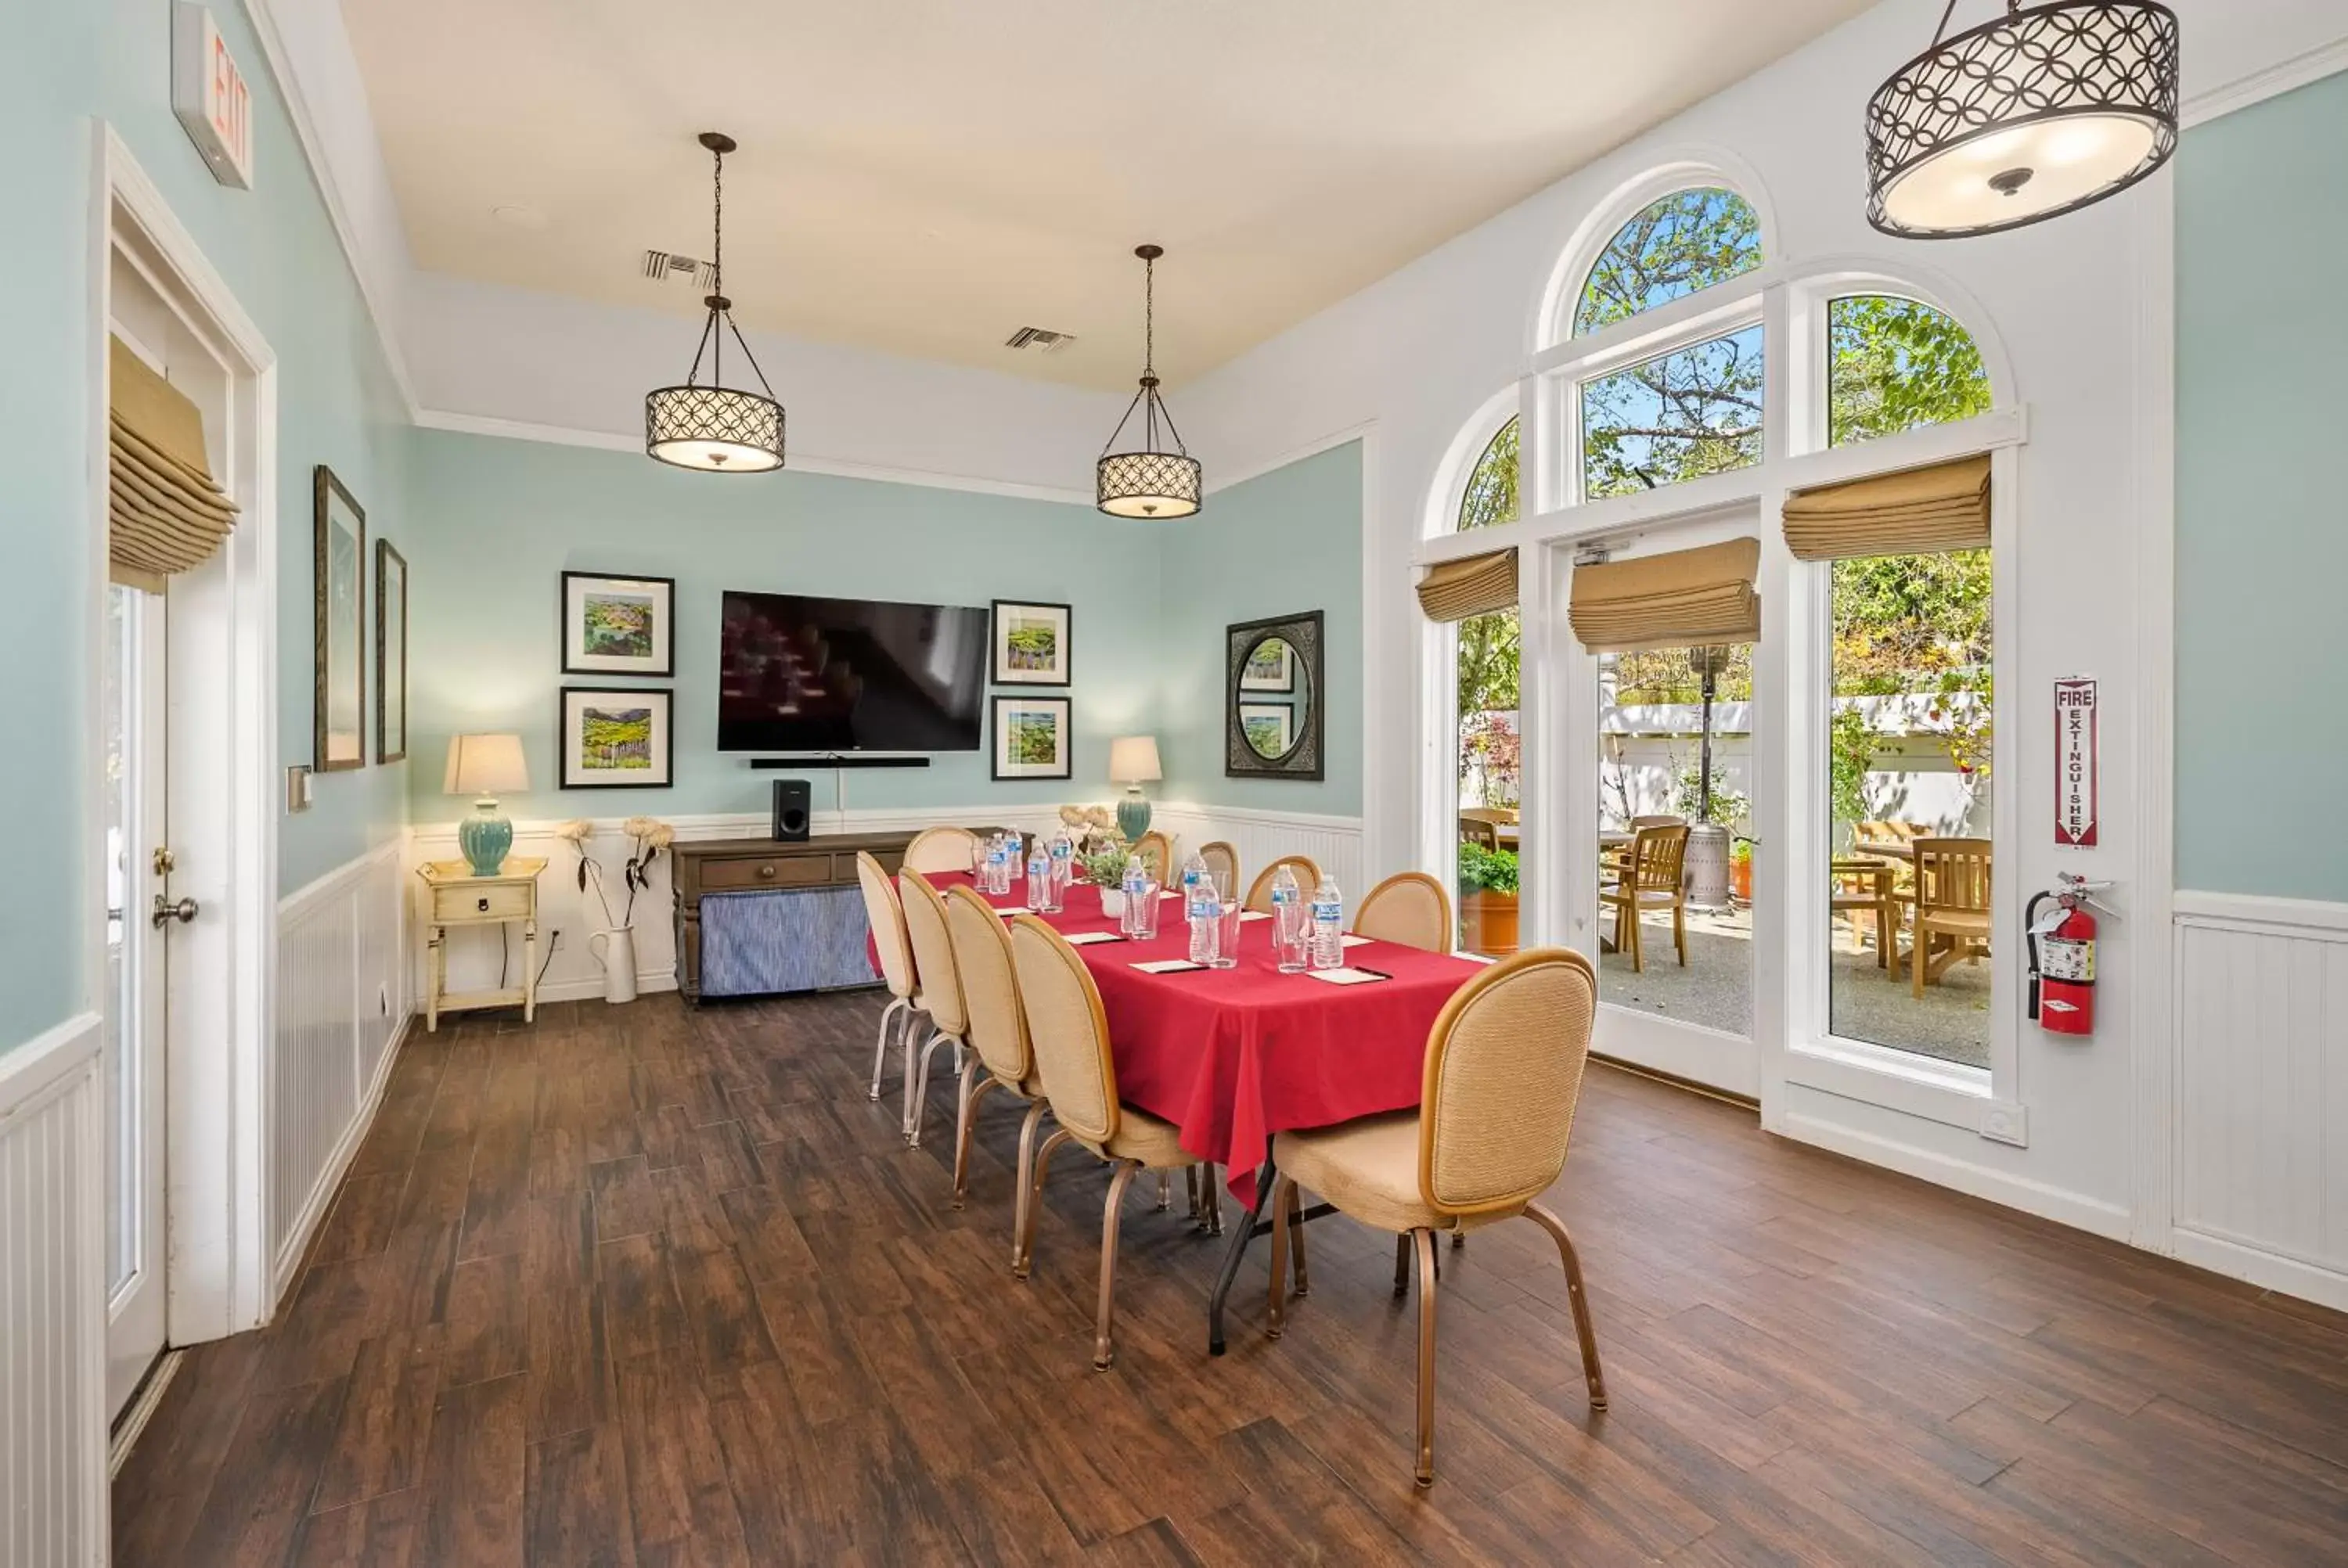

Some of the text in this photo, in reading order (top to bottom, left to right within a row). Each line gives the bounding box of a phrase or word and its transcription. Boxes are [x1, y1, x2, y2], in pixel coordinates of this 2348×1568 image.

[216, 33, 248, 169] EXIT
[2059, 691, 2092, 706] FIRE
[2069, 710, 2082, 836] EXTINGUISHER
